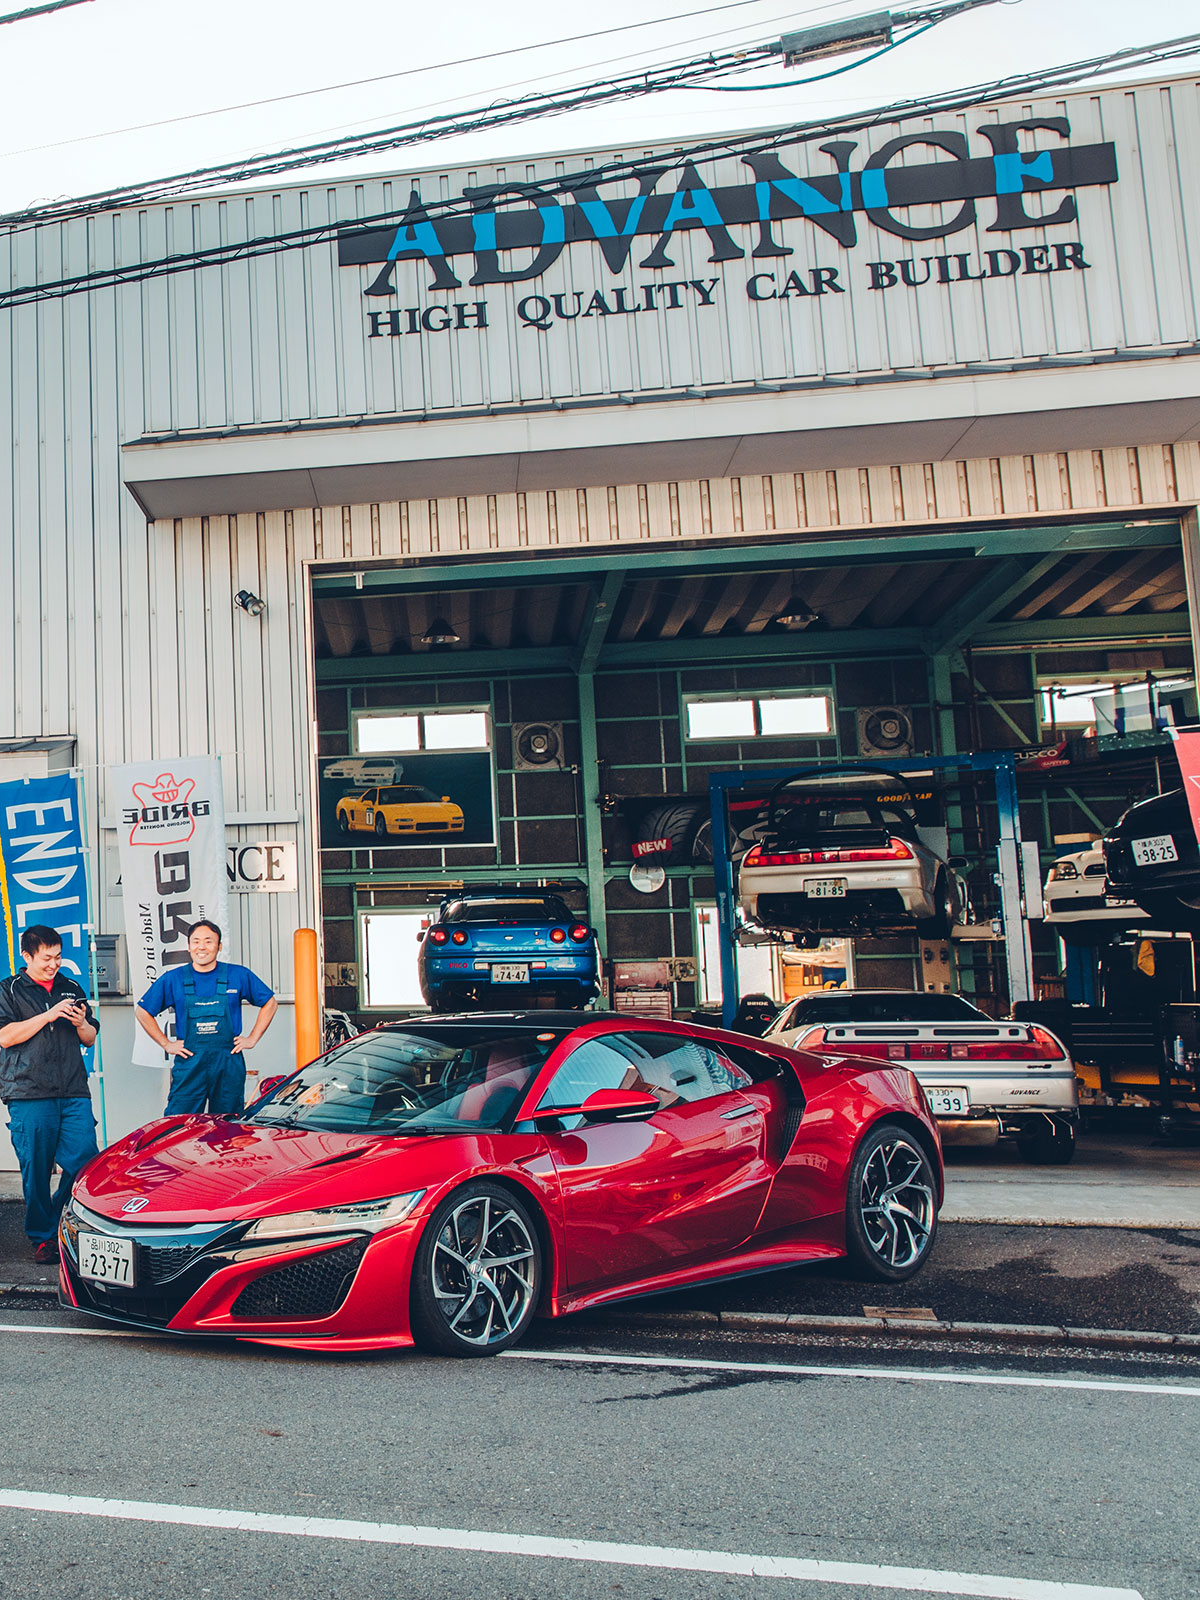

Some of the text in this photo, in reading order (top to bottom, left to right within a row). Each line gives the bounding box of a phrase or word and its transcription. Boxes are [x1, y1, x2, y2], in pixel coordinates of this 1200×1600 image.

[363, 116, 1077, 297] ADVANCE
[367, 242, 1092, 339] HIGH QUALITY CAR BUILDER
[637, 839, 667, 855] NEW
[1142, 845, 1175, 862] 98-25
[815, 886, 844, 896] 81-85
[500, 970, 526, 981] 74-47
[90, 1253, 130, 1281] 23-77
